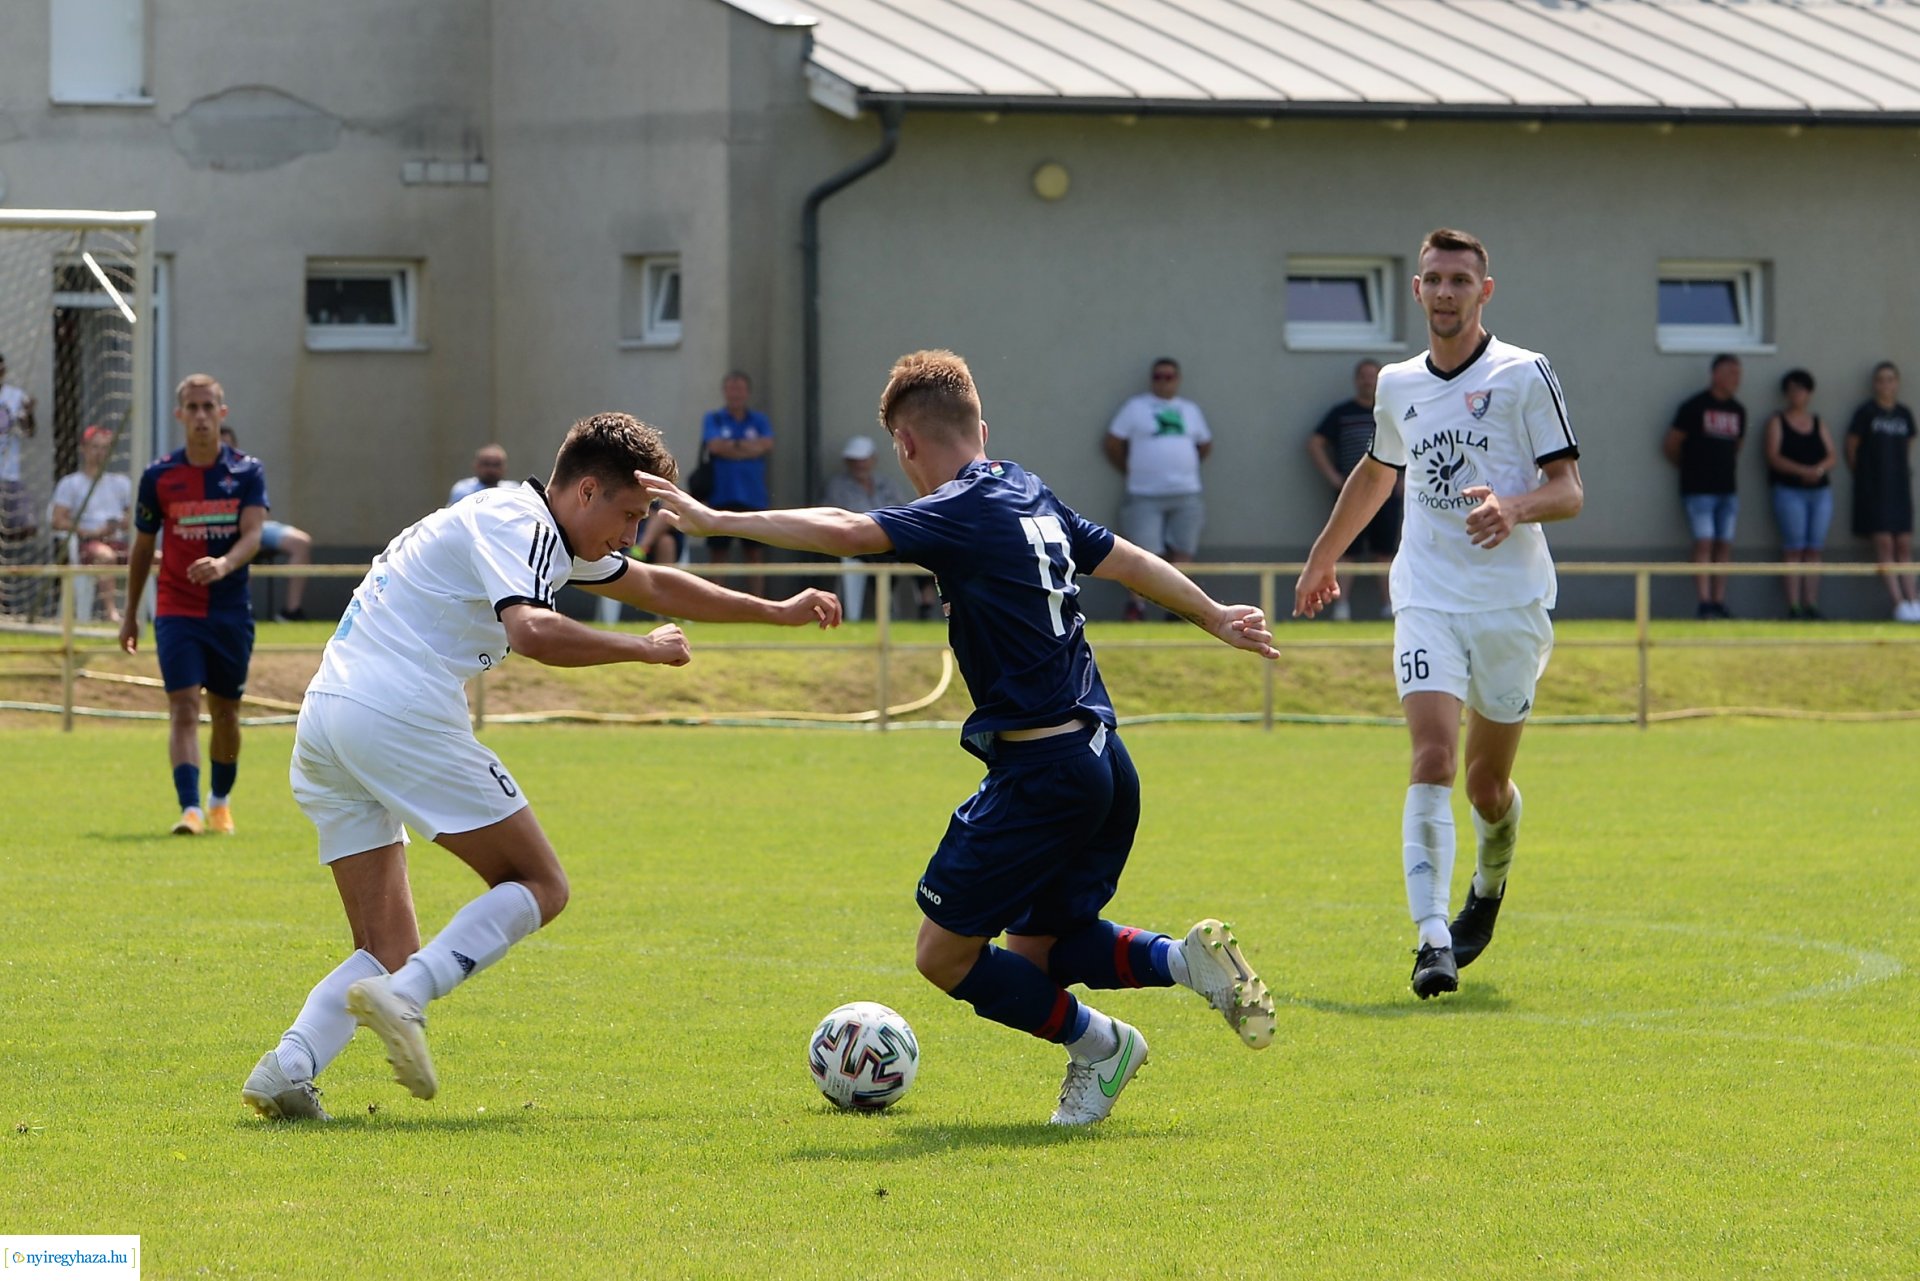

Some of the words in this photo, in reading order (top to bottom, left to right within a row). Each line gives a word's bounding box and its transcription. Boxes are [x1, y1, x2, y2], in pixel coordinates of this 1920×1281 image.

[1411, 429, 1488, 460] KAMILLA
[1019, 516, 1081, 636] 17
[1400, 649, 1429, 684] 56
[489, 763, 517, 797] 6
